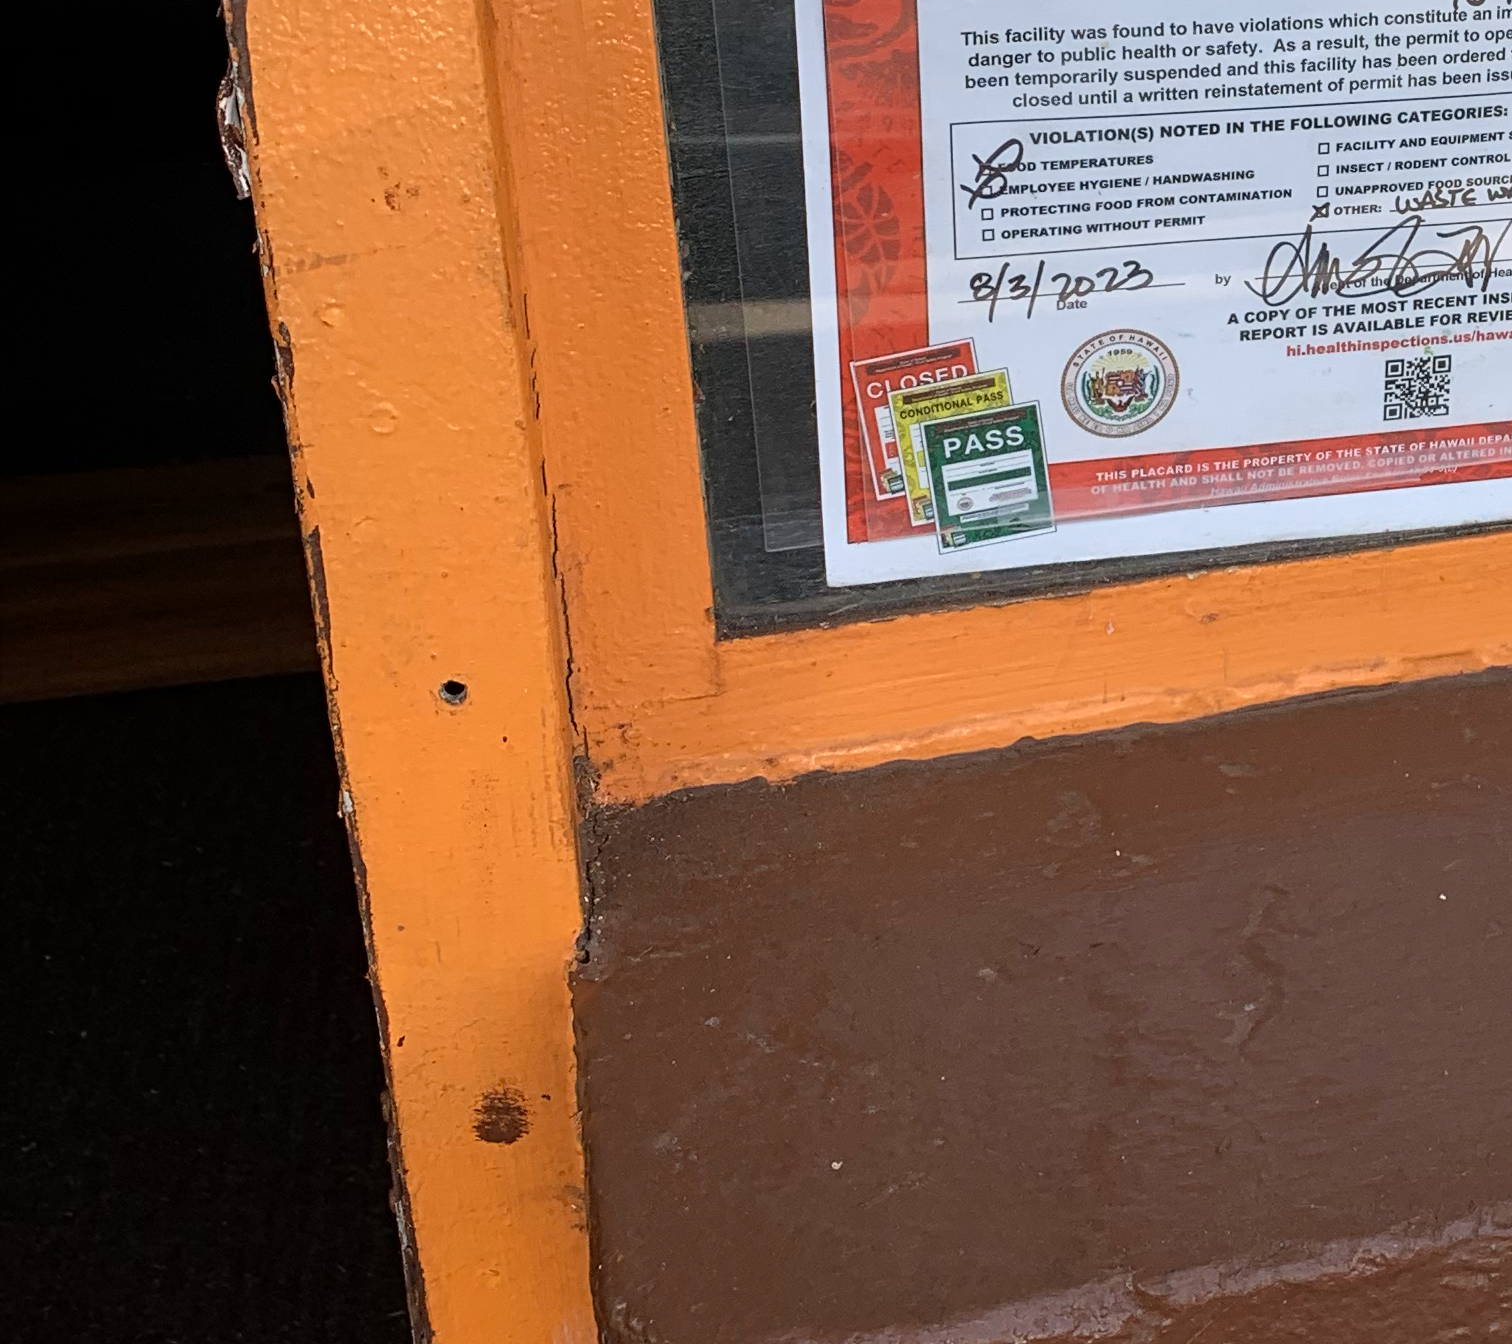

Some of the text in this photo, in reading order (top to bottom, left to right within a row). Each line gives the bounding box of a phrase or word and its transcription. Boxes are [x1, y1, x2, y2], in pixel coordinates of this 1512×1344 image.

[961, 31, 999, 46] This
[1005, 27, 1064, 43] facility
[1071, 27, 1107, 41] was
[1113, 23, 1164, 38] found
[1170, 24, 1187, 35] to
[1193, 21, 1234, 35] have
[1240, 17, 1323, 34] violations
[1329, 14, 1379, 28] which
[1385, 9, 1467, 25] constitute
[1473, 10, 1492, 21] an
[1030, 106, 1508, 145] VIOLATION(S) NOTED IN THE FOLLOWING CATEGORIES:
[1336, 139, 1395, 152] FACILITY
[1400, 137, 1426, 148] AND
[1431, 132, 1505, 146] EQUIPMENT
[1041, 155, 1154, 171] TEMPERATURES
[1336, 154, 1511, 174] INSECT RODENT CONTROL
[1080, 178, 1141, 190] HYGIENE
[1153, 170, 1254, 185] HANDWASHING
[1336, 182, 1423, 196] UNAPPROVED
[1428, 179, 1462, 189] FOOD
[1001, 189, 1292, 217] PROTECTING FOOD FROM CONTAMINATION
[1334, 204, 1381, 214] OTHER:
[1396, 188, 1477, 214] WASTE
[1001, 216, 1205, 239] OPERATING WITHOUT PERMIT
[970, 259, 1154, 322] 8/3/2023
[1215, 274, 1231, 286] by
[1056, 299, 1087, 311] Date
[1227, 313, 1239, 325] A
[1244, 309, 1288, 324] COPY
[1295, 308, 1318, 319] OF
[1322, 305, 1356, 317] THE
[1361, 301, 1406, 314] MOST
[1413, 295, 1477, 311] RECENT
[1240, 326, 1307, 342] REPORT
[1312, 325, 1327, 336] IS
[1333, 318, 1425, 335] AVAILABLE
[1430, 315, 1462, 327] FOR
[900, 397, 973, 419] CONDITIONAL
[976, 391, 1004, 404] PASS
[943, 425, 1024, 459] PASS
